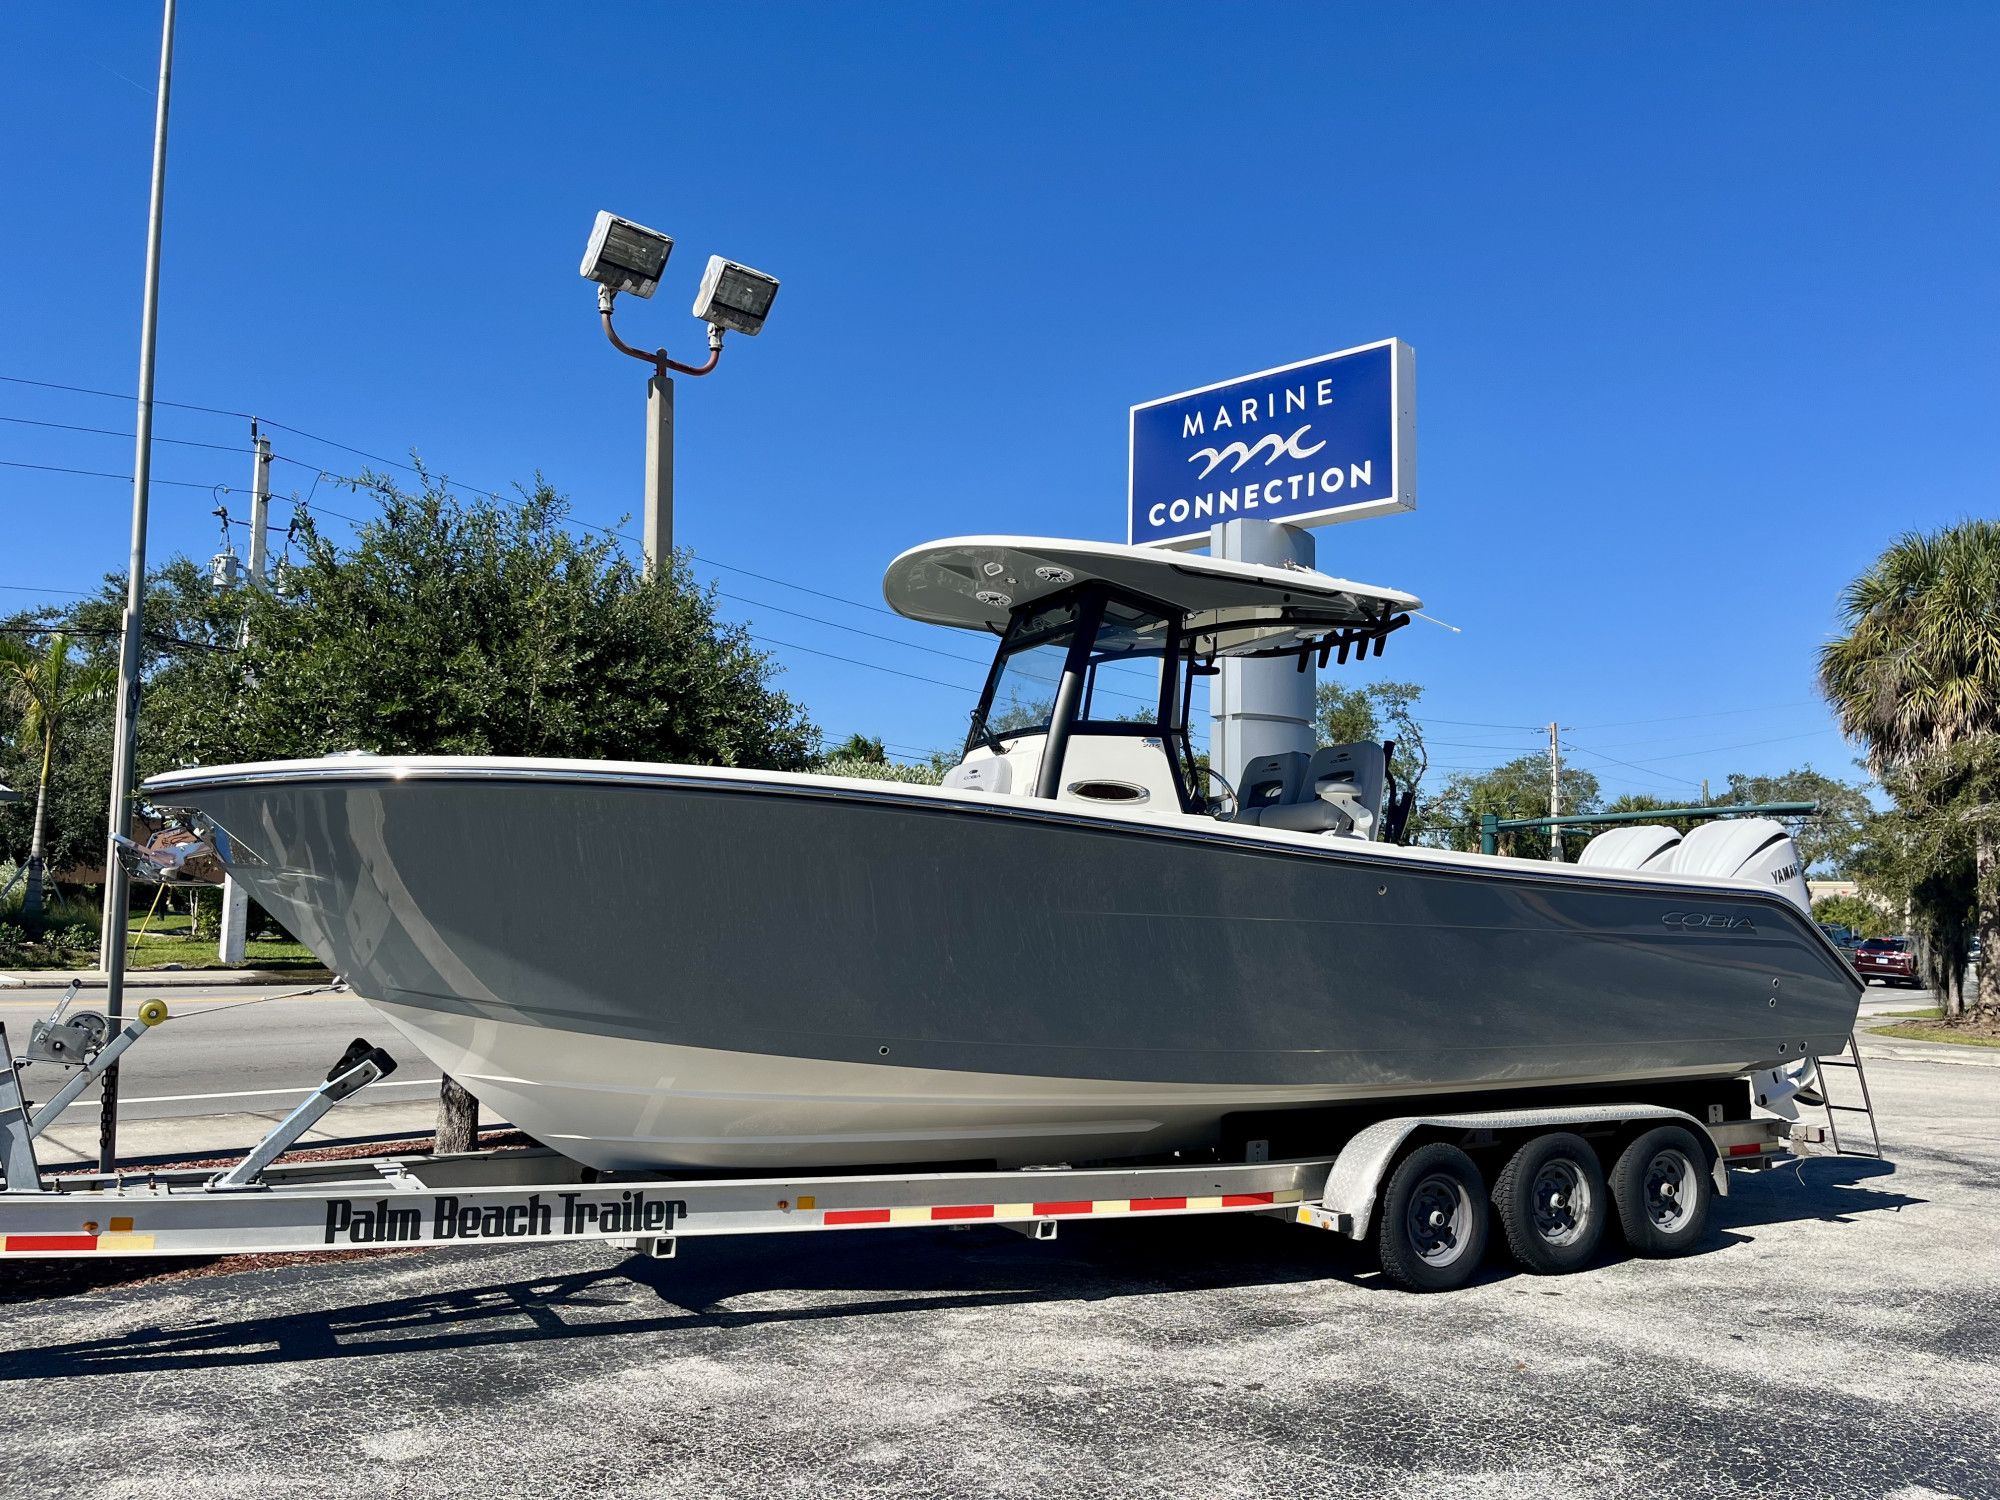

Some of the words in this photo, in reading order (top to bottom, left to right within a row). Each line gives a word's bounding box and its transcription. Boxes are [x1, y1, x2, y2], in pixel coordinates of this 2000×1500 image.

[1183, 378, 1333, 439] MARINE
[1148, 460, 1372, 527] CONNECTION
[1661, 911, 1755, 930] COBIA
[325, 1199, 421, 1244] Palm
[434, 1193, 552, 1239] Beach
[558, 1190, 688, 1235] Trailer
